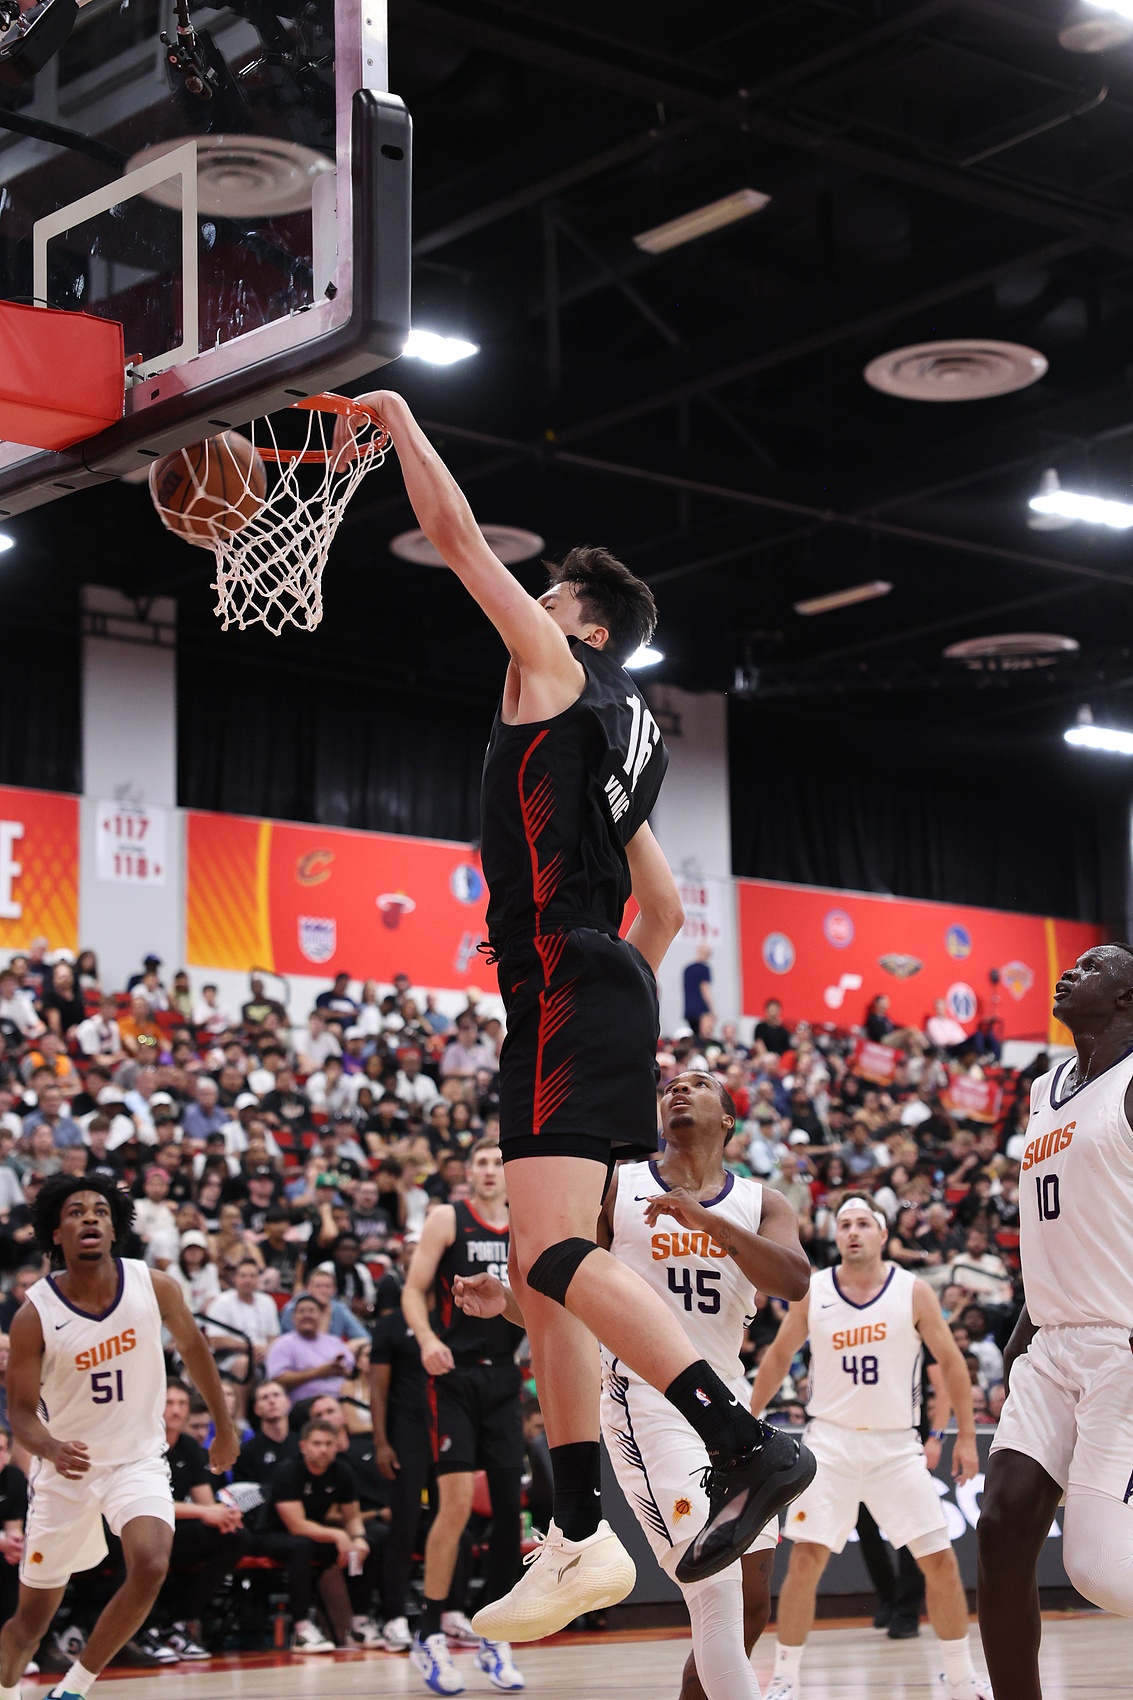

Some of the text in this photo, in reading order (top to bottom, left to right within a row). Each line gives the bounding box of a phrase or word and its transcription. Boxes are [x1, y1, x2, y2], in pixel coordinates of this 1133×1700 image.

[623, 693, 661, 793] 16
[115, 814, 149, 840] 117
[1022, 1120, 1077, 1171] SUNS
[1035, 1173, 1060, 1221] 10
[466, 1240, 509, 1262] PORTL
[666, 1267, 721, 1314] 45
[75, 1328, 137, 1371] SUNS
[832, 1322, 887, 1350] SUNS
[91, 1369, 124, 1404] 51
[842, 1355, 879, 1385] 48
